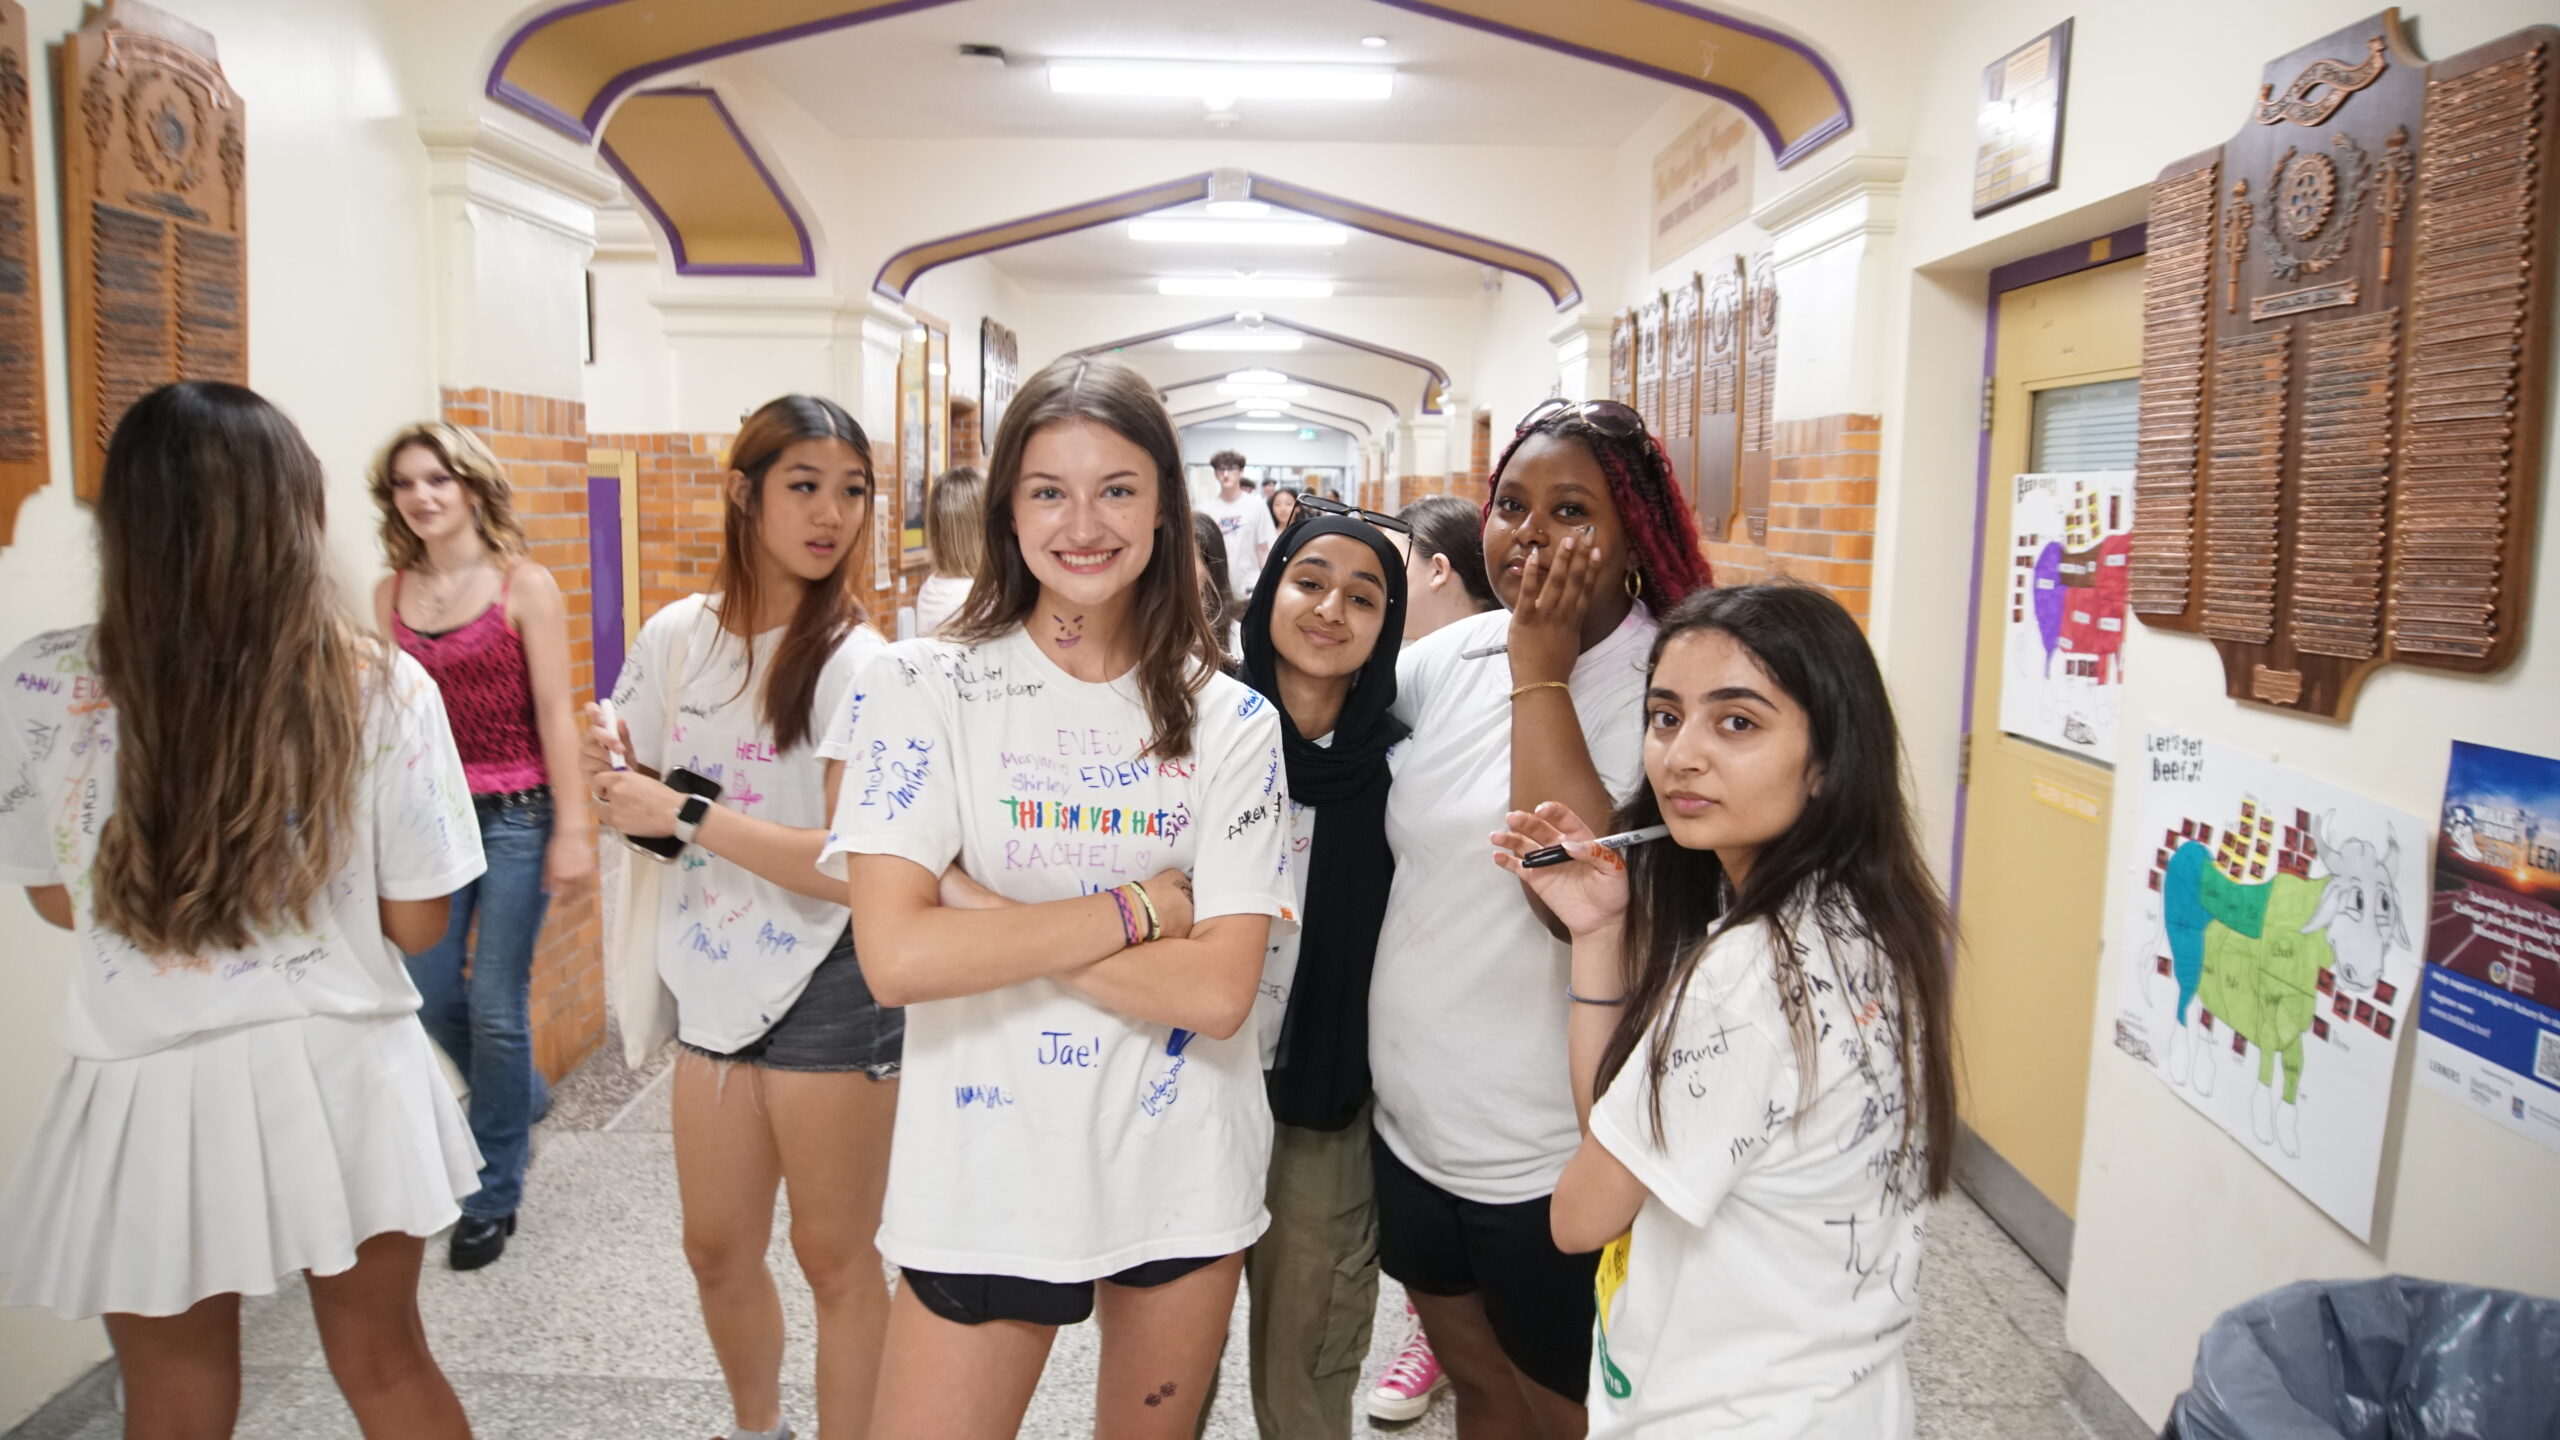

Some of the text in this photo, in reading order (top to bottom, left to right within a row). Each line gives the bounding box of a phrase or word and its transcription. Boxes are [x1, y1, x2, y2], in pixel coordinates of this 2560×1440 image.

[1012, 773, 1072, 799] Shirley
[1080, 758, 1150, 789] EDEN
[1005, 840, 1126, 875] RACHEL
[2452, 900, 2486, 922] College
[1038, 1031, 1099, 1068] Jae!
